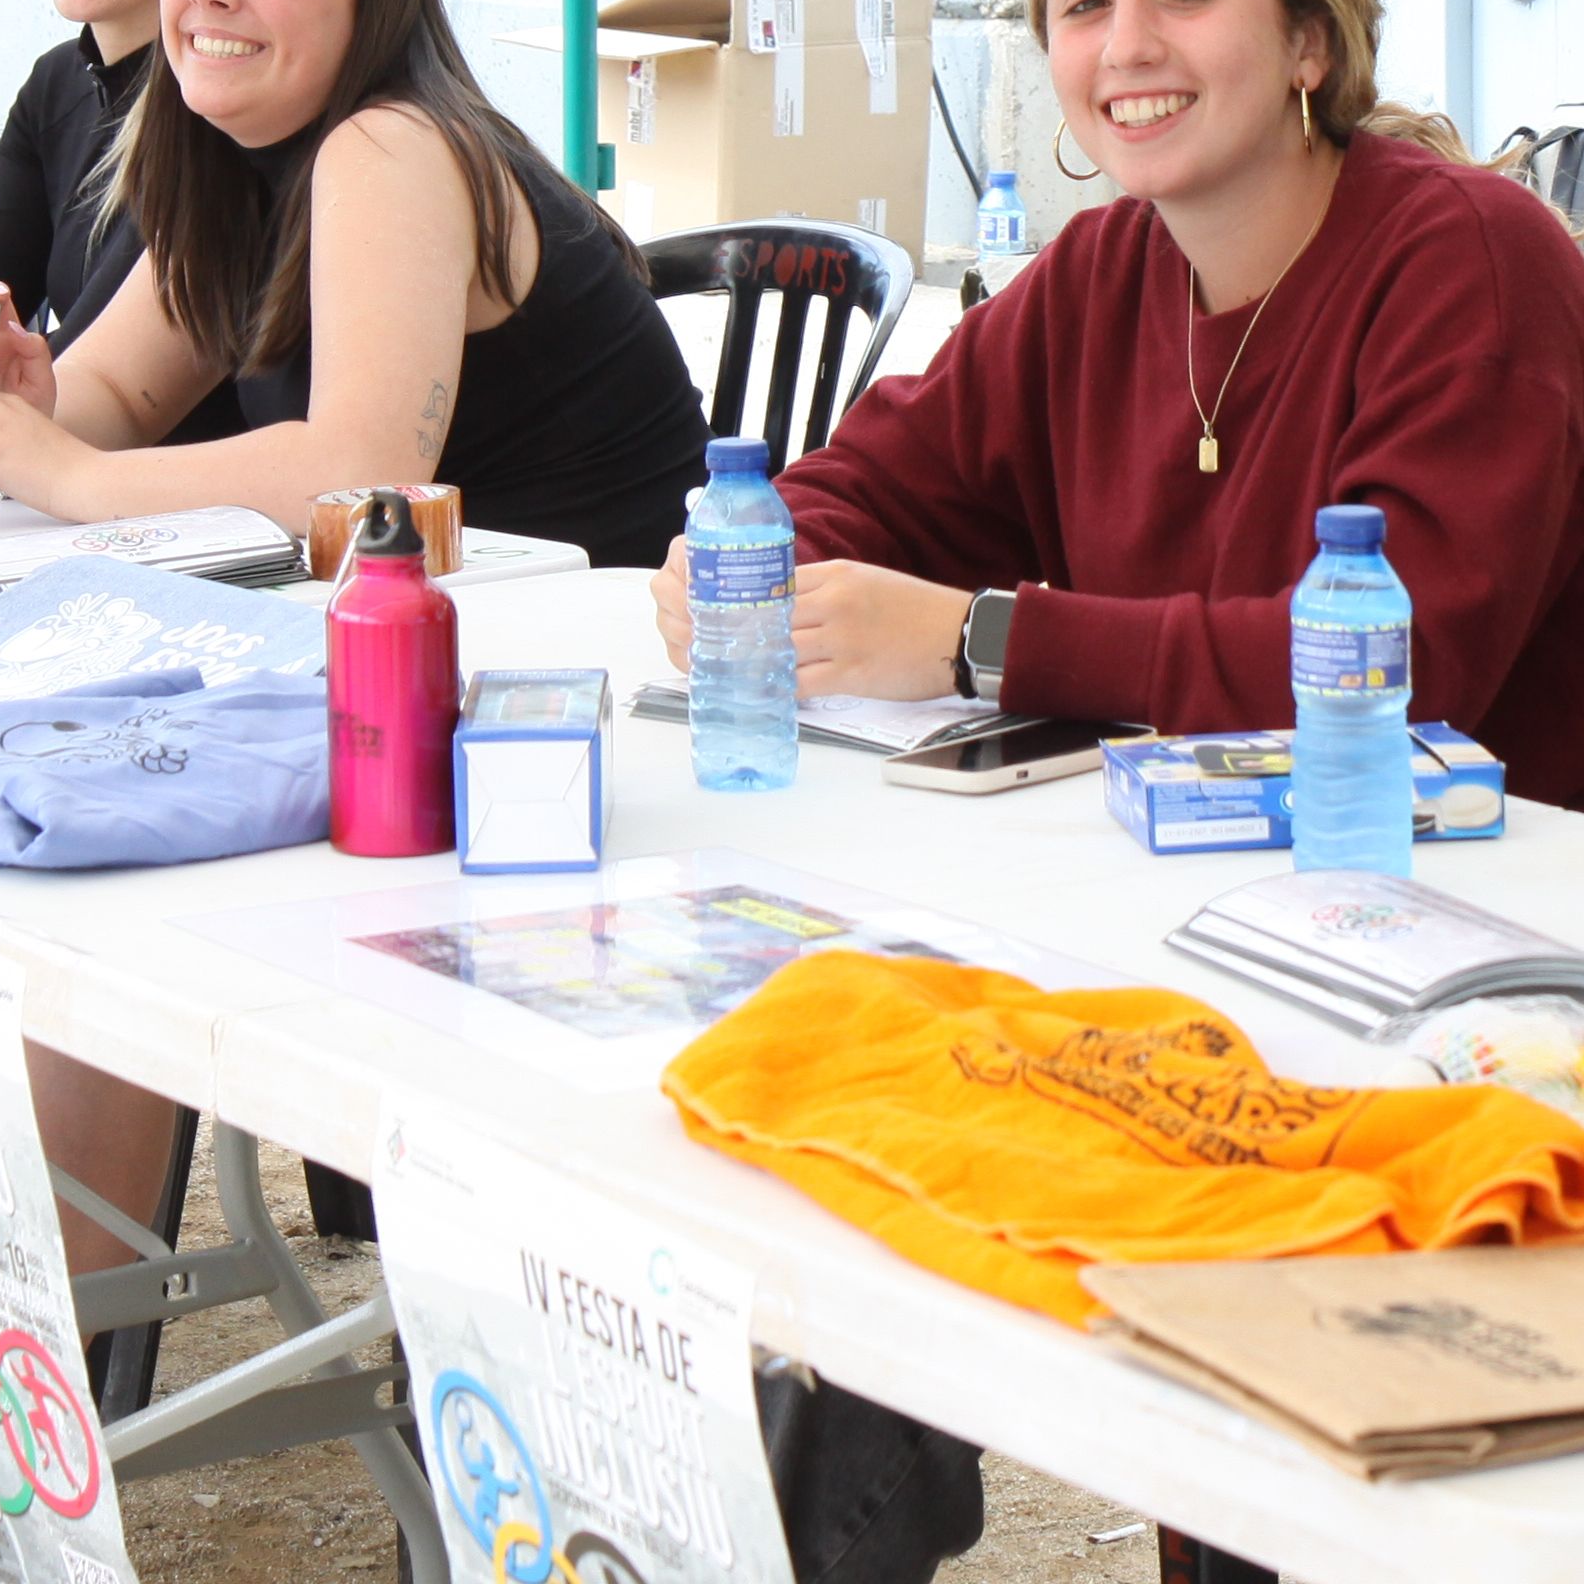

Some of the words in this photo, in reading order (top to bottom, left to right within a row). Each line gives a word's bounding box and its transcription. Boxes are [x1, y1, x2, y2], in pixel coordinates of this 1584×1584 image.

[159, 619, 265, 659] JOCS
[4, 1241, 28, 1283] 19
[520, 1247, 549, 1314] IV
[559, 1269, 651, 1370] FESTA
[658, 1321, 699, 1395] DE
[530, 1385, 734, 1572] INCLUSIU
